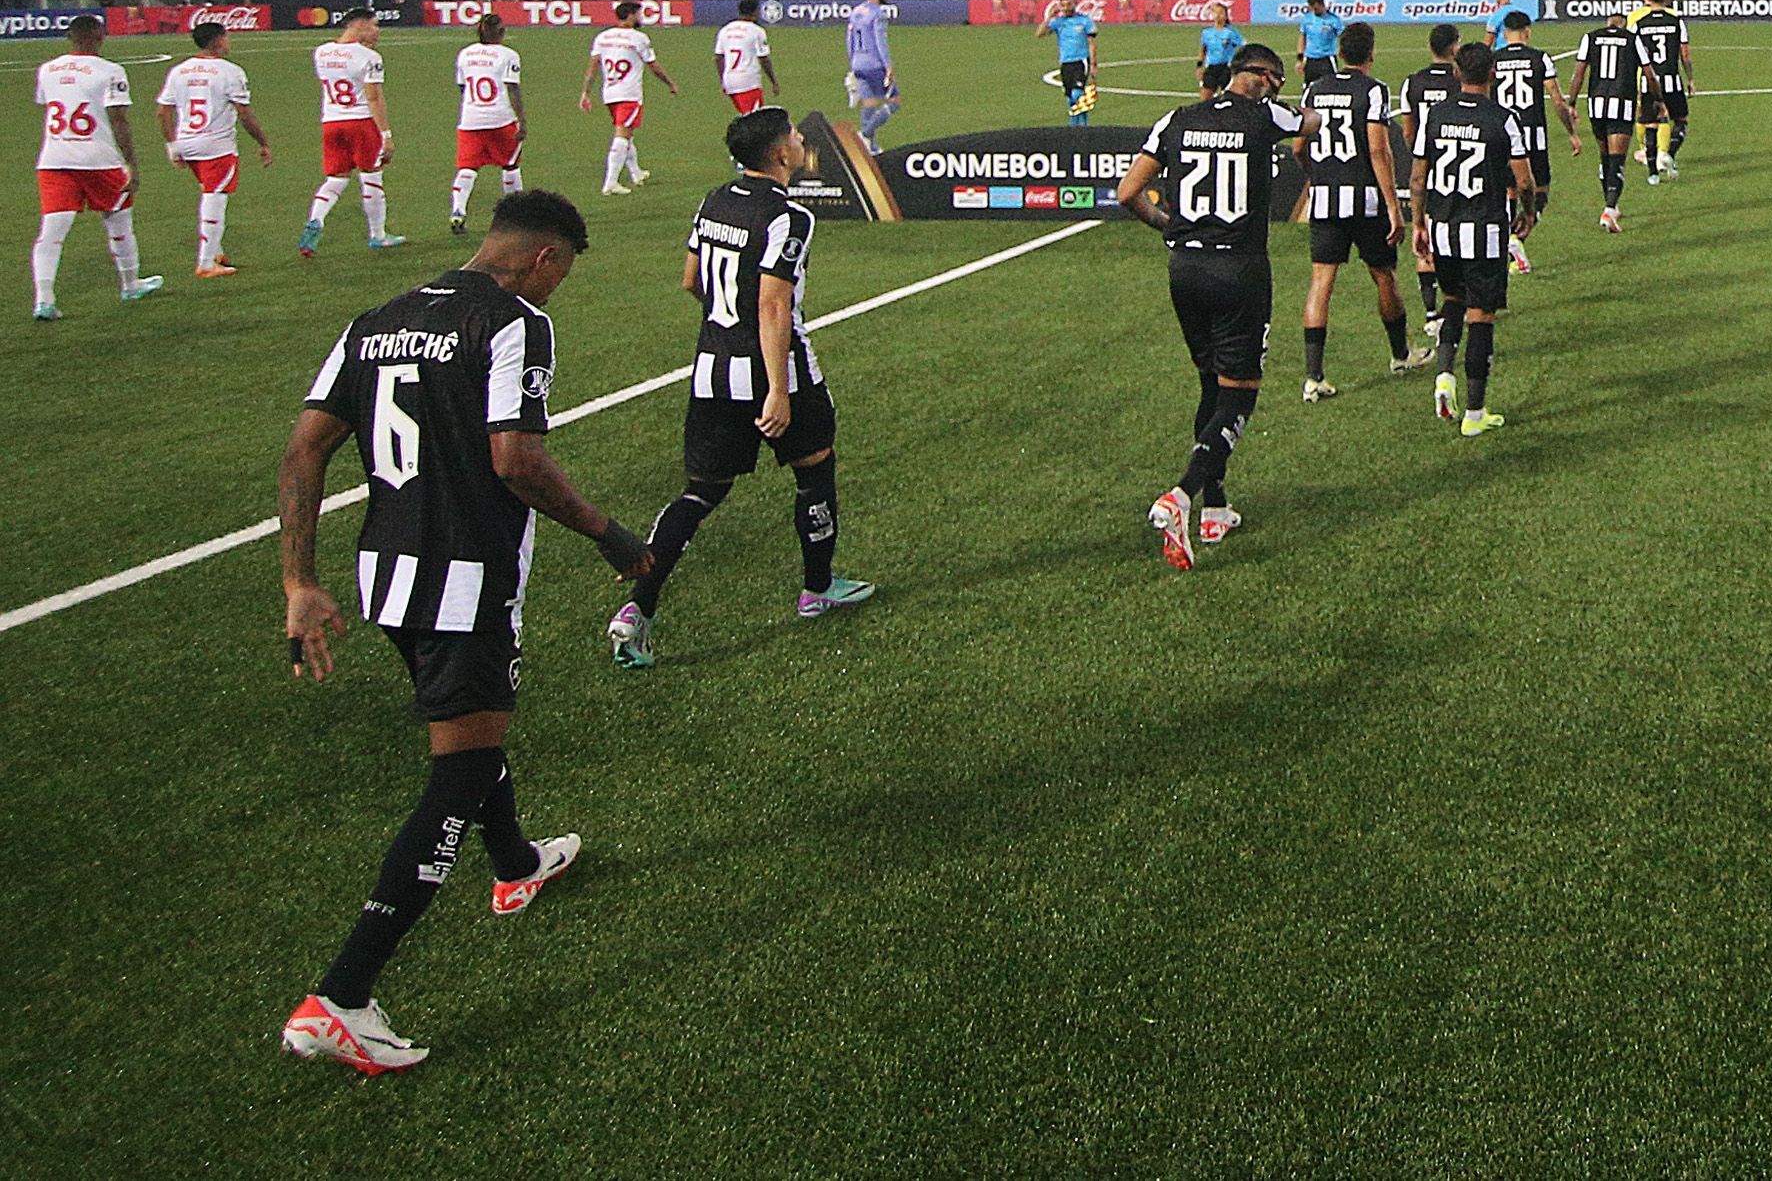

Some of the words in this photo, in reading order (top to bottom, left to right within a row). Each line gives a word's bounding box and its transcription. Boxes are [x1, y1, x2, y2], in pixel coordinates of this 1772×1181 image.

[523, 0, 591, 24] TCL
[730, 49, 742, 69] 7
[1600, 45, 1618, 79] 11
[1652, 35, 1667, 64] 3
[604, 58, 632, 81] 29
[322, 79, 357, 106] 18
[466, 76, 498, 102] 10
[1496, 70, 1534, 109] 26
[48, 100, 97, 136] 36
[189, 99, 208, 129] 5
[1183, 130, 1244, 149] BARBOZA
[1310, 108, 1357, 163] 33
[905, 152, 1066, 178] CONMEBOL
[1434, 139, 1486, 199] 22
[1180, 151, 1248, 223] 20
[701, 242, 740, 329] 10
[372, 364, 419, 490] 6
